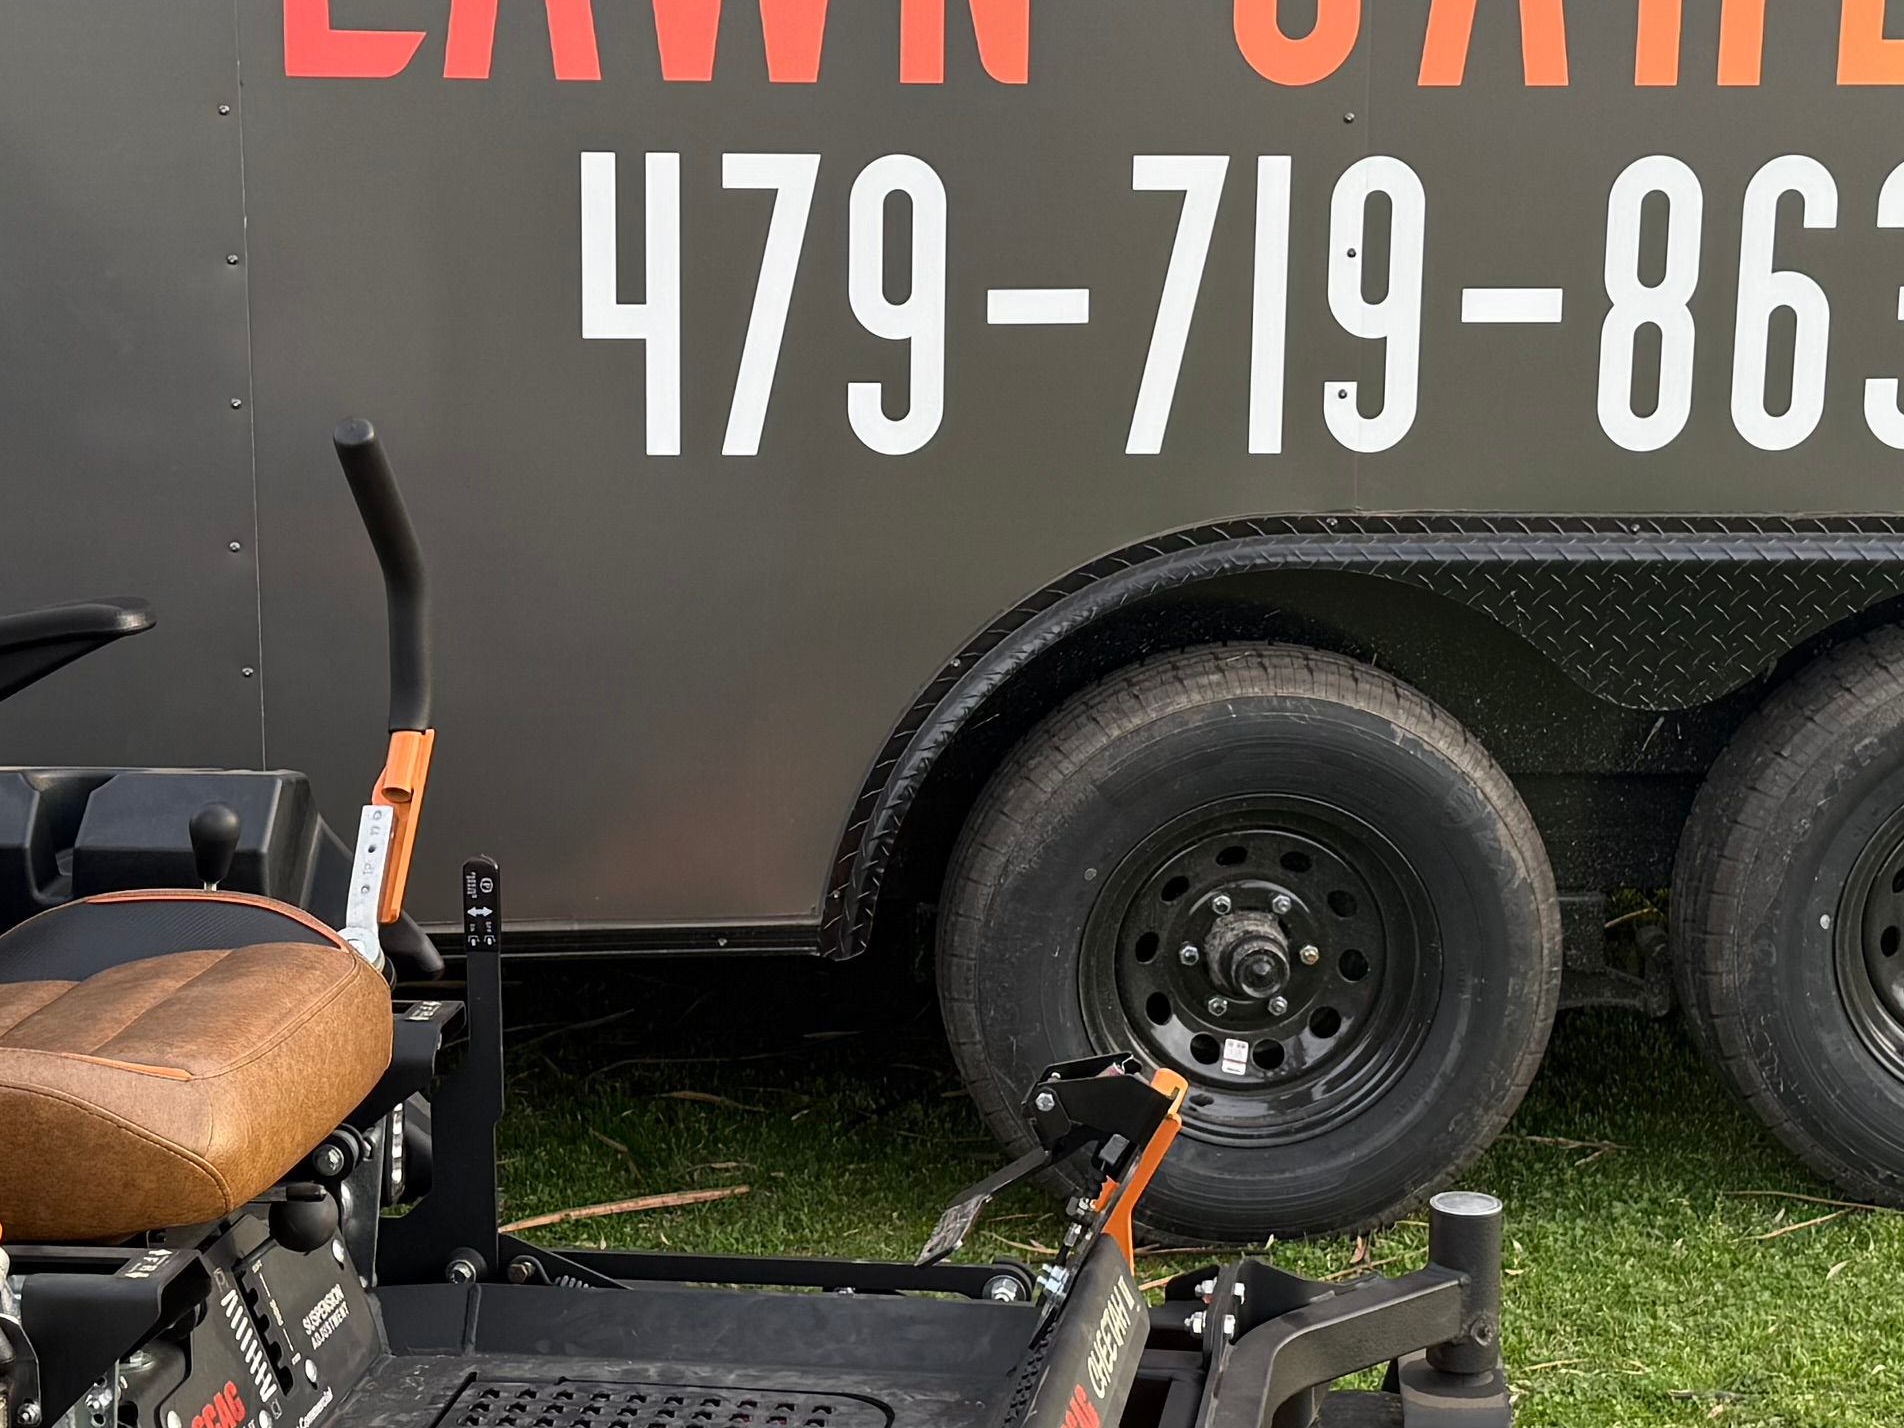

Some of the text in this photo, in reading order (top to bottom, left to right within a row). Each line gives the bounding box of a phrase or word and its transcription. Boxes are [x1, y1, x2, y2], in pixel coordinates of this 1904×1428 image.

[302, 1283, 345, 1335] SUSPENSION
[311, 1301, 350, 1351] ADJUSTMENT
[1087, 1285, 1132, 1400] CHEETAH
